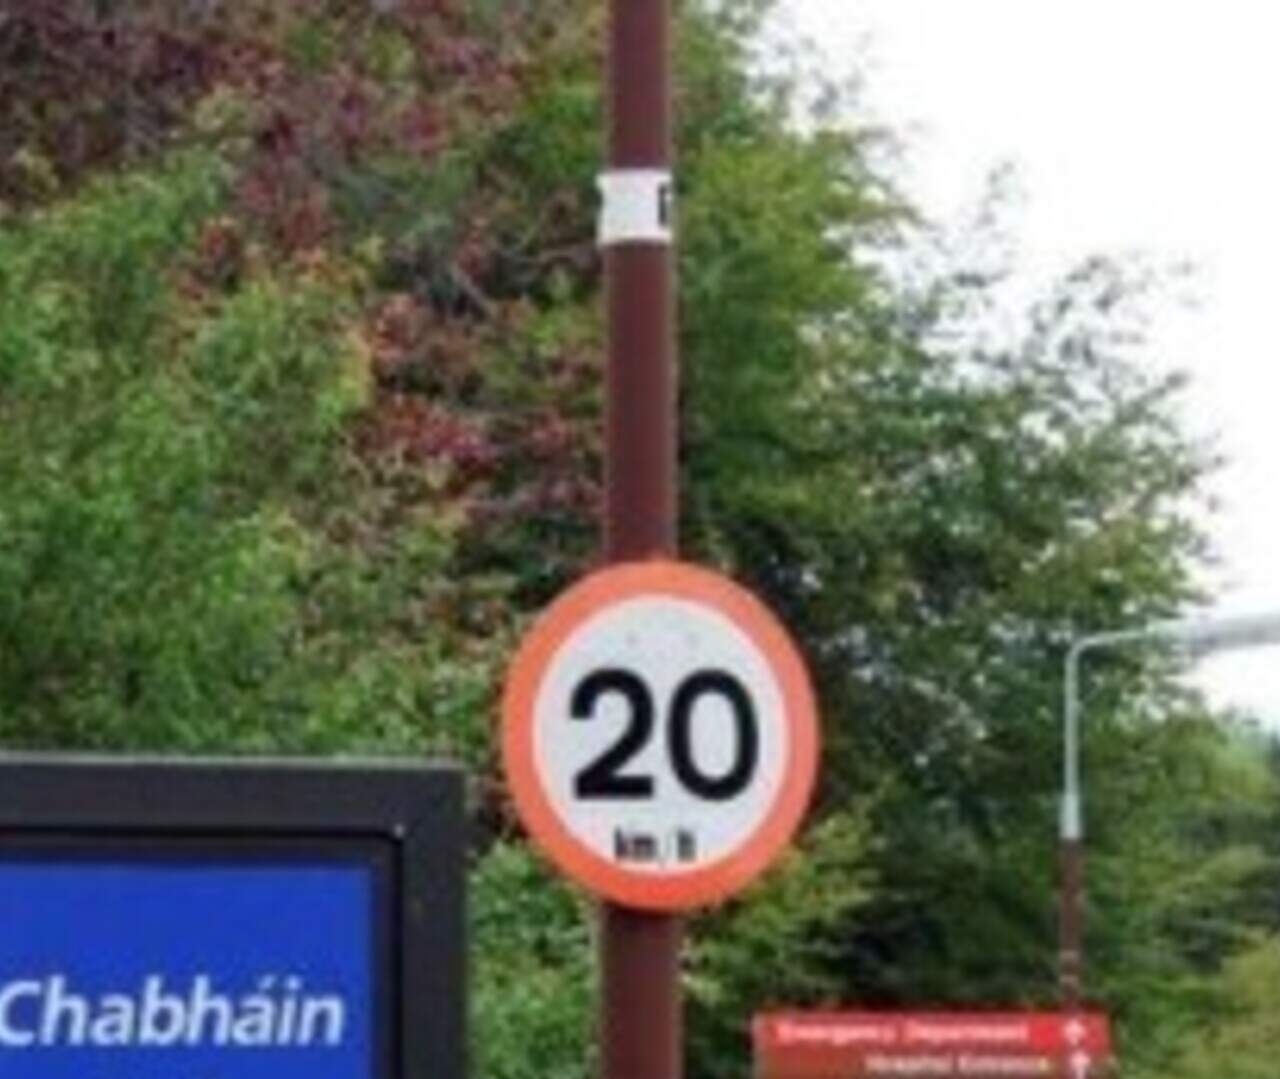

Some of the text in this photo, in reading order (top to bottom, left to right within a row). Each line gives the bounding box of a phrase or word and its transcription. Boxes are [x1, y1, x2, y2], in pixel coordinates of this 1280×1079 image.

[569, 667, 760, 802] 20
[613, 827, 697, 866] km/h
[904, 1020, 1030, 1045] Department
